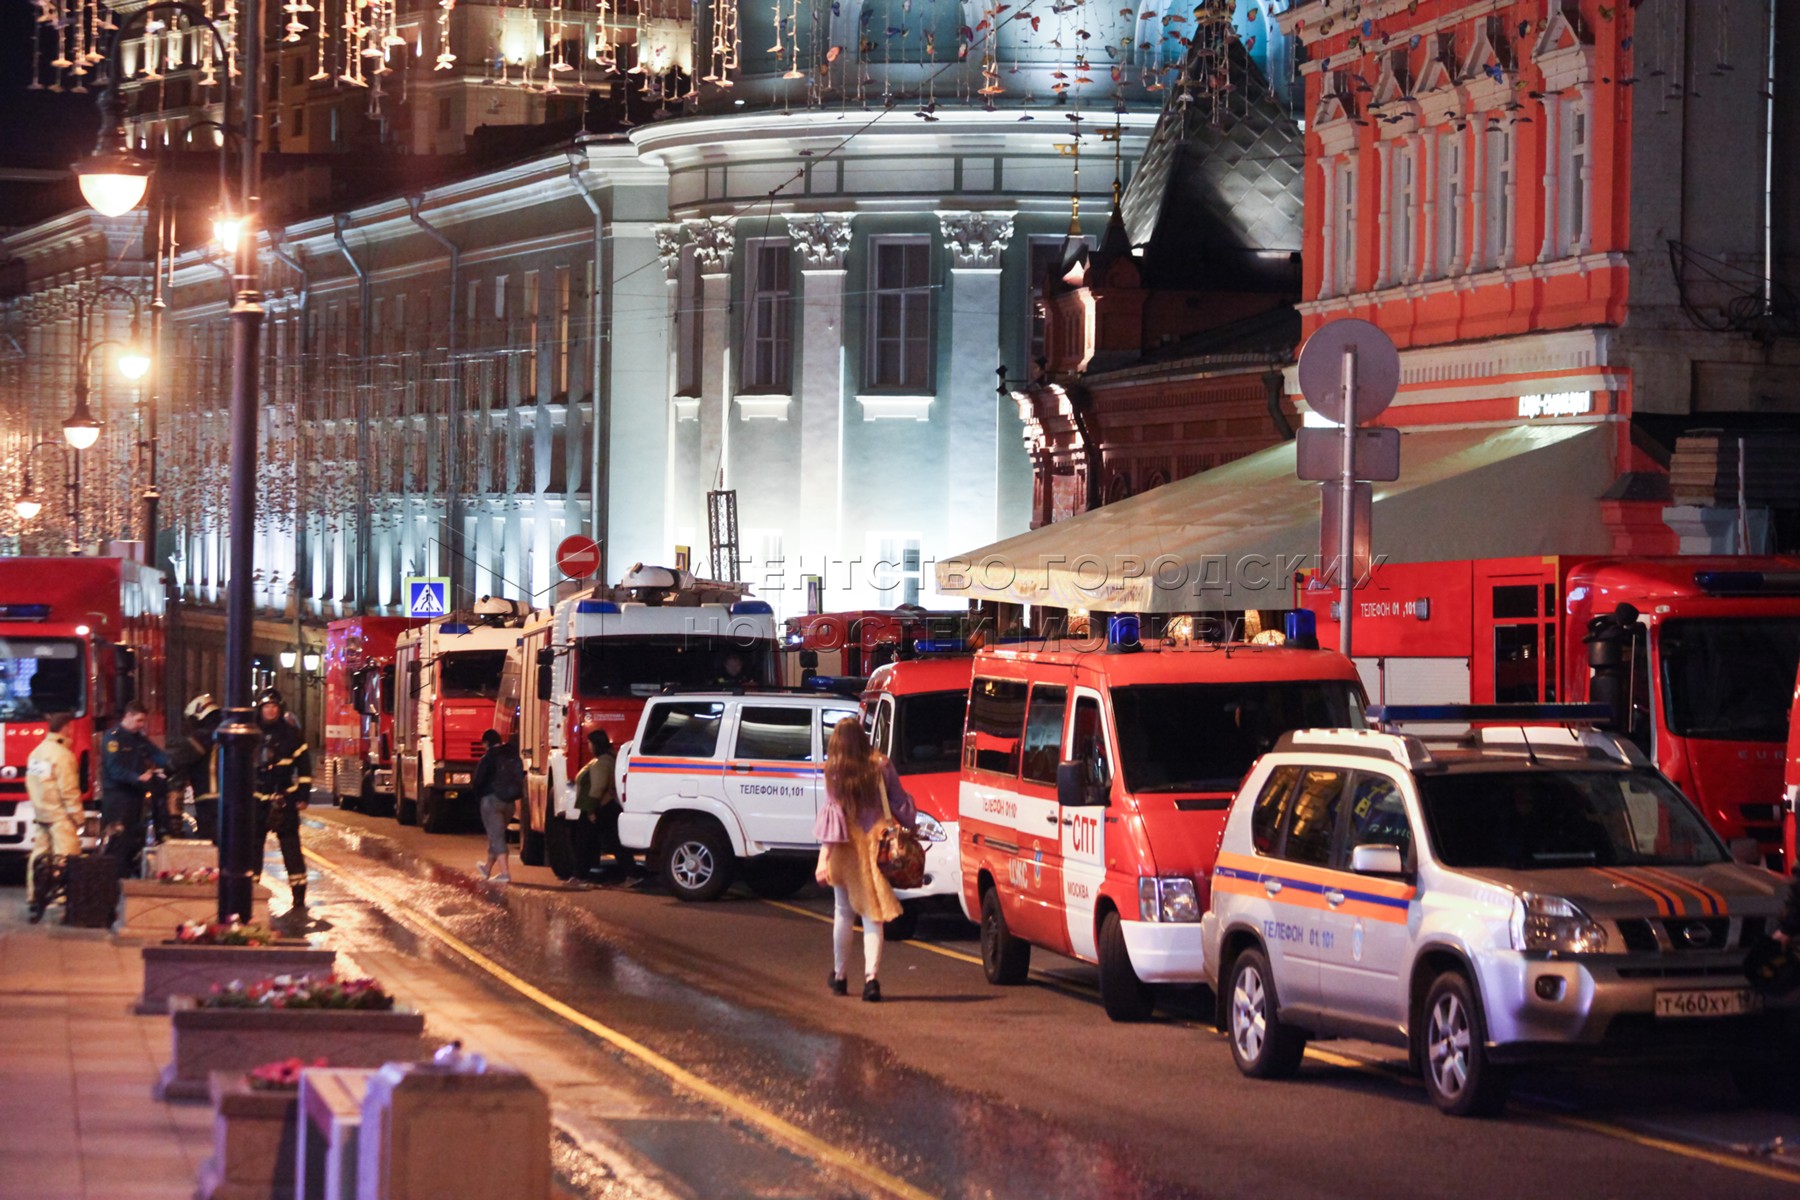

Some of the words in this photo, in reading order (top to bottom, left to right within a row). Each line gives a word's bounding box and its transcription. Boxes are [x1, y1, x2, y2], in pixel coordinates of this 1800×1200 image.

[1360, 602, 1391, 617] ТЕЛЕФОН
[1392, 602, 1400, 615] 01
[739, 784, 778, 796] ТЕЛЕФОН
[780, 786, 804, 798] 01,101
[1073, 814, 1097, 854] СПТ
[1067, 881, 1089, 899] МОСКВА
[1263, 920, 1304, 943] ТЕЛЕФОН
